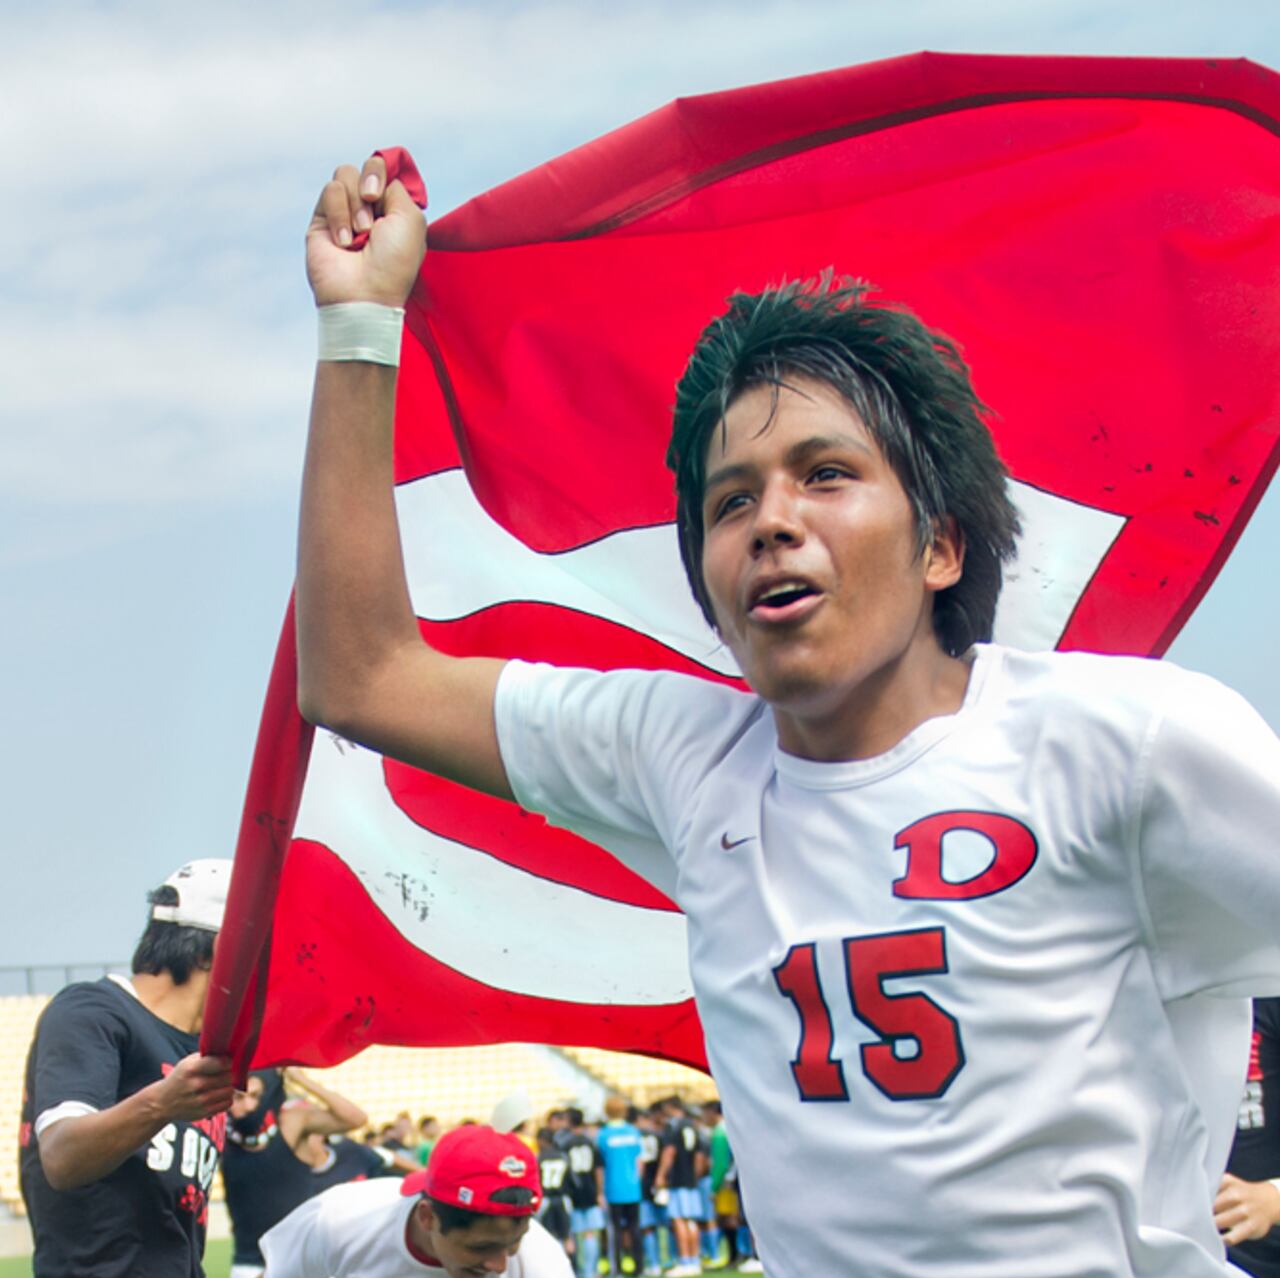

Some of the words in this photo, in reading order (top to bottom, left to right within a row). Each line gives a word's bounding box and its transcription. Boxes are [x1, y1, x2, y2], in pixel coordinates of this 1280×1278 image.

[892, 809, 1039, 901] D
[772, 926, 967, 1102] 15
[540, 1158, 567, 1189] 17
